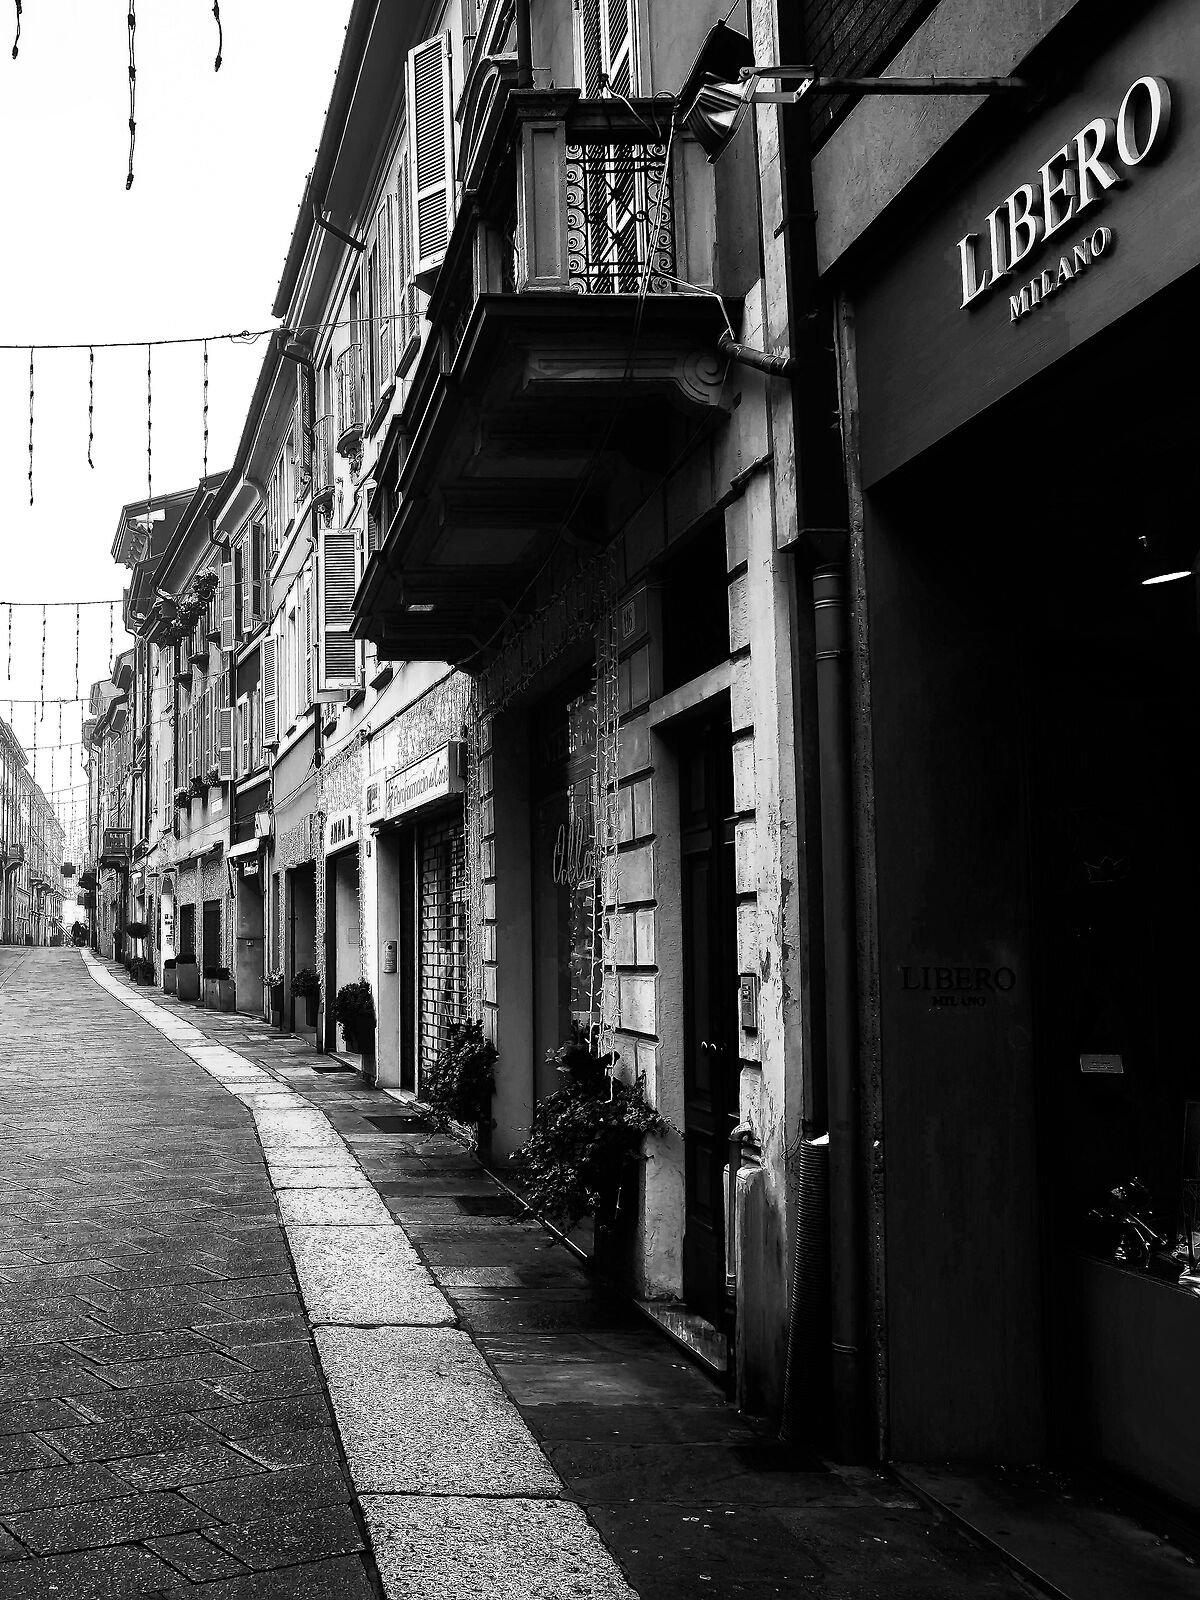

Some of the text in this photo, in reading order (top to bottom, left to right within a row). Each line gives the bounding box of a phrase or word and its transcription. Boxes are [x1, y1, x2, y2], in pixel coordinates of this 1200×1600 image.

[956, 75, 1172, 309] LIBERO
[1009, 226, 1112, 322] MILANO
[901, 966, 1016, 991] LIBERO
[933, 996, 986, 1006] MILANO
